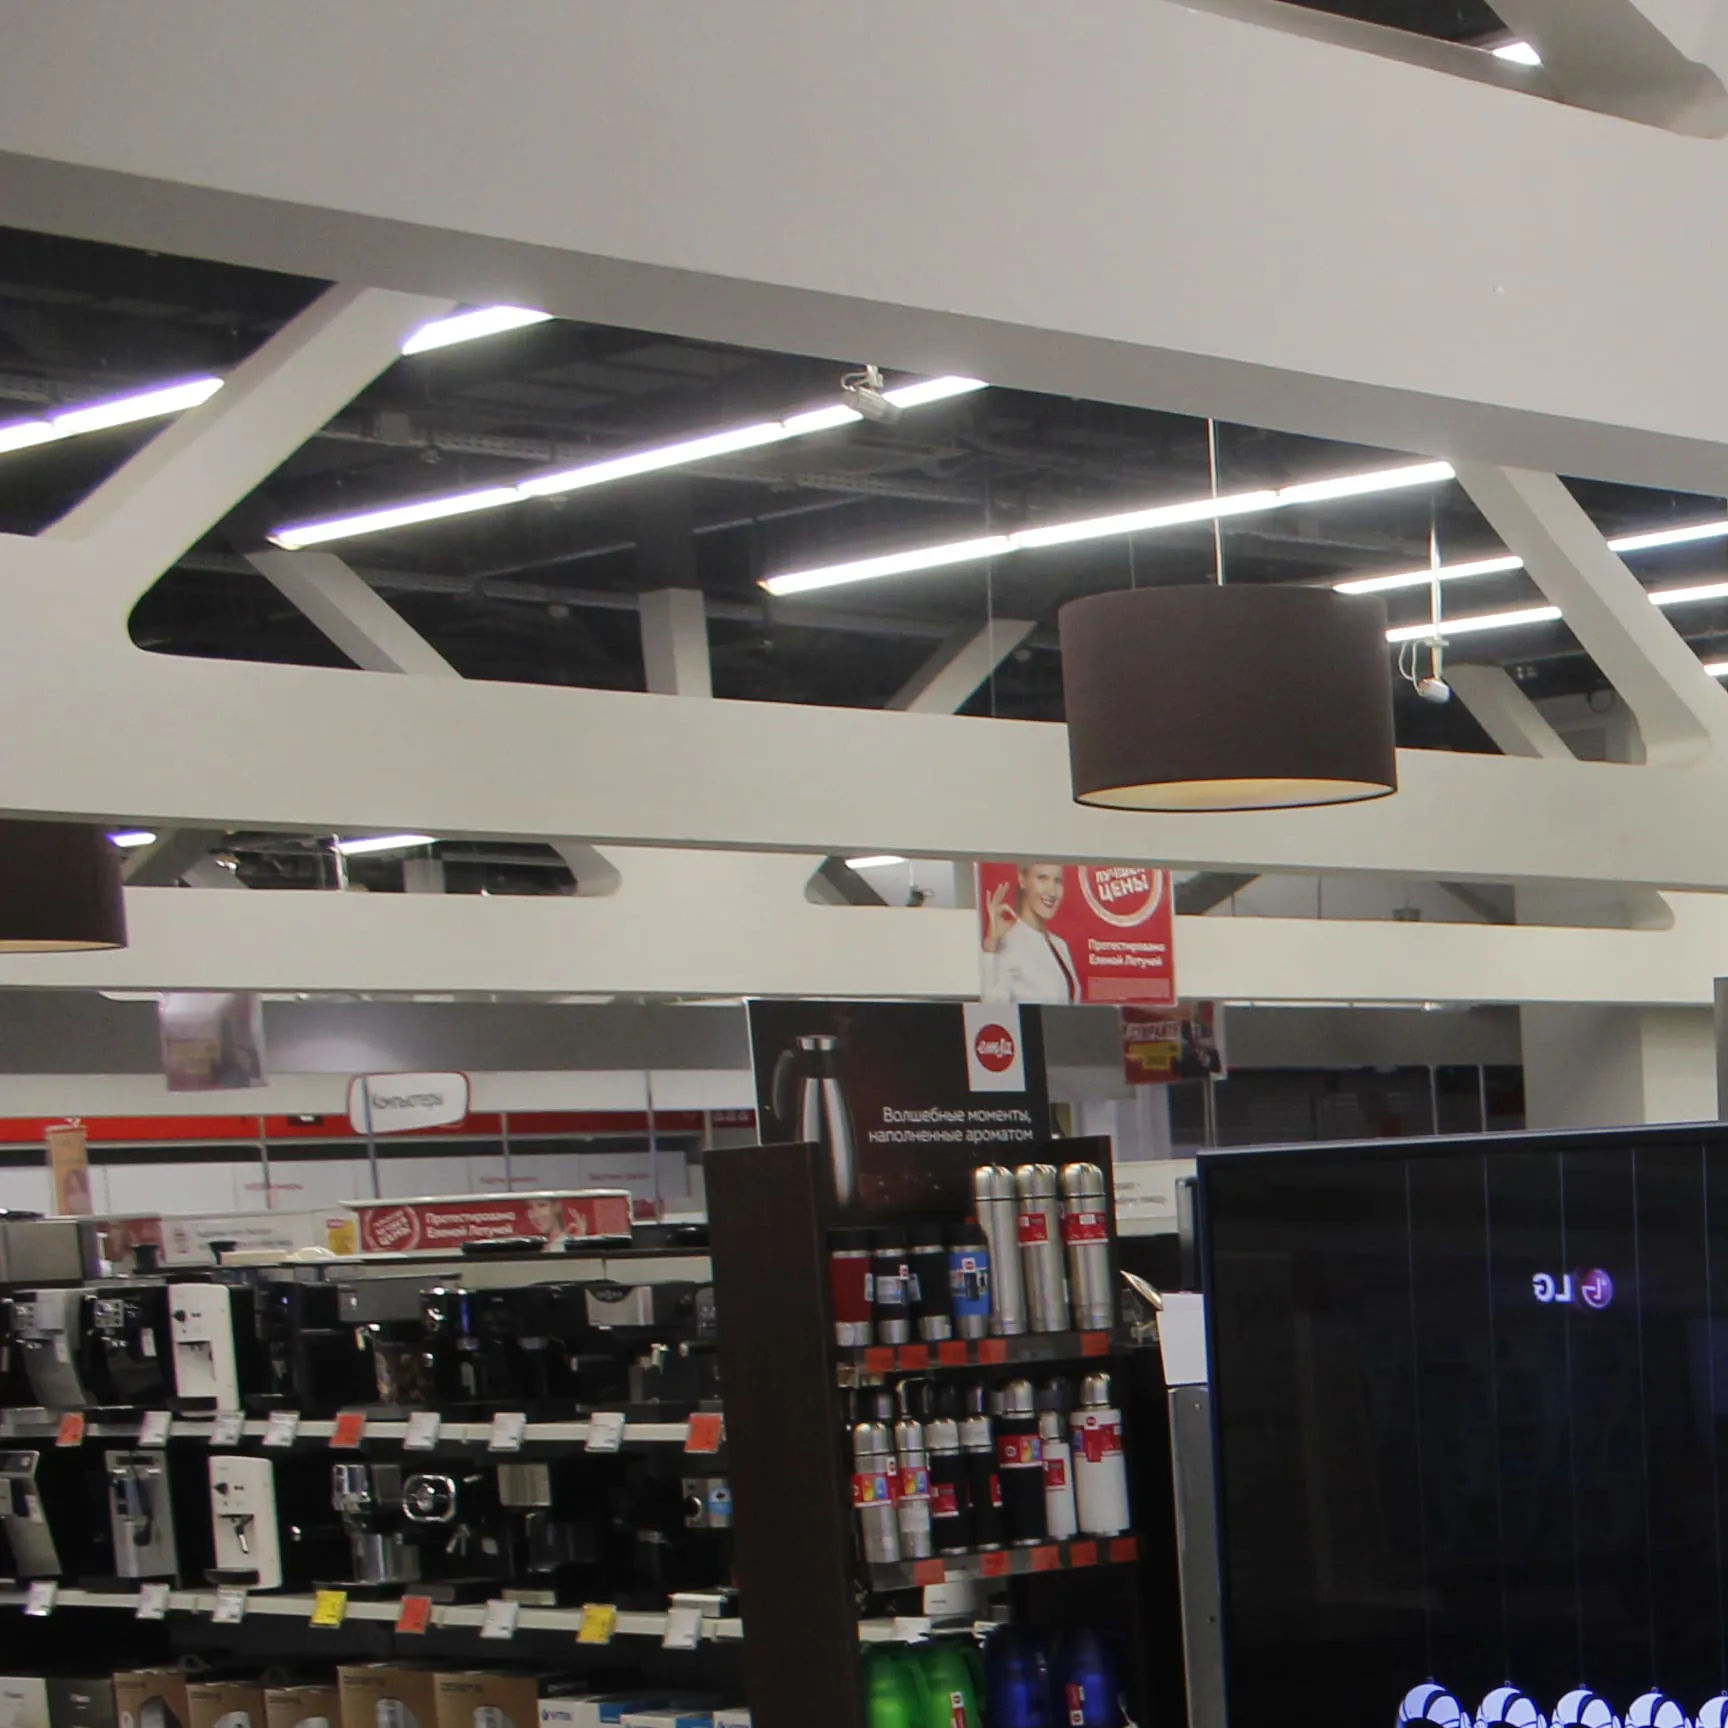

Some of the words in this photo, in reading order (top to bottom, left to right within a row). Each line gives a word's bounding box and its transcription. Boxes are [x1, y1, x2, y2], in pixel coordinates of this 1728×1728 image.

[1098, 874, 1149, 902] ЦЕНЫ
[883, 1106, 965, 1124] Волшебные
[868, 1129, 963, 1144] наполненные
[965, 1129, 1034, 1145] ароматом
